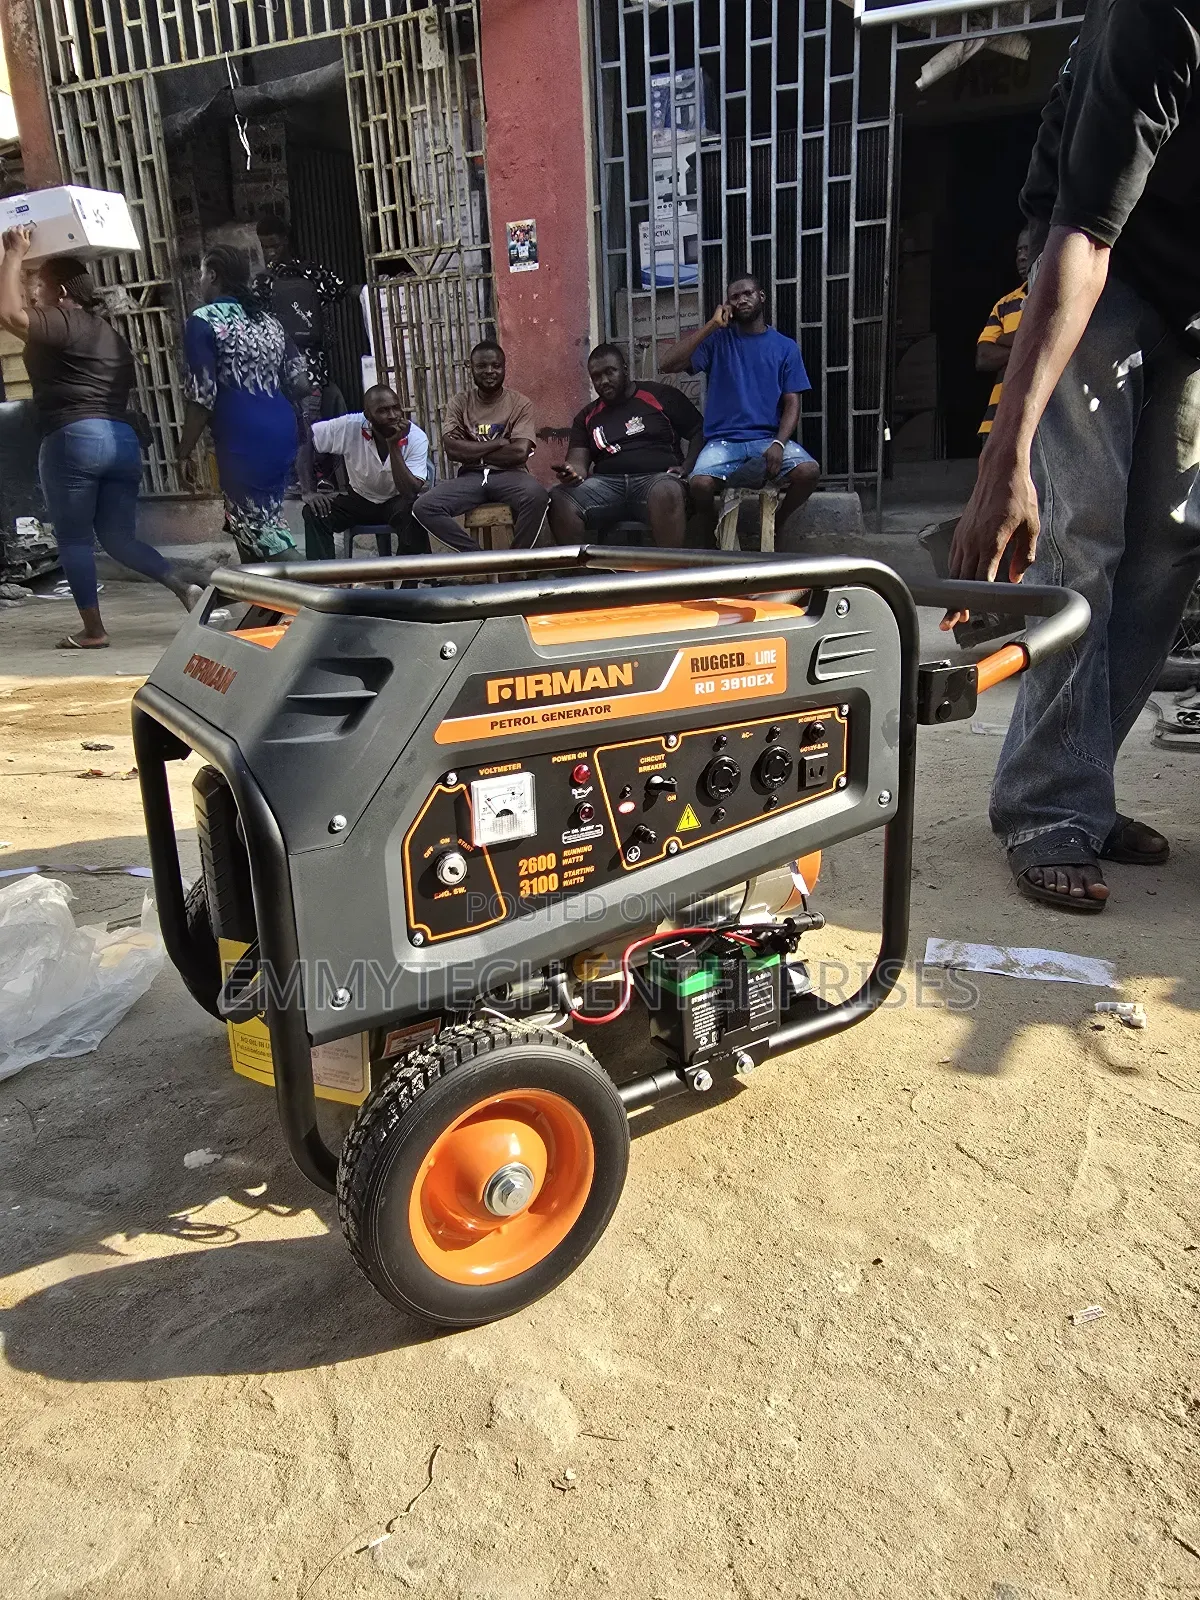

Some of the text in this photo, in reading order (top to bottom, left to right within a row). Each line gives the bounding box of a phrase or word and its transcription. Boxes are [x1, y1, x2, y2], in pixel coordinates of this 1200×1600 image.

[690, 649, 777, 673] RUGGED LINE
[183, 653, 238, 695] FIRMAN
[487, 662, 634, 704] FIRMAN
[694, 681, 715, 695] RD
[490, 704, 612, 730] PETROL GENERATOR
[552, 751, 588, 763] POWER ON
[640, 754, 666, 764] CIRCUIT
[478, 762, 522, 776] VOLTMETER
[638, 762, 667, 773] BREAKER
[666, 794, 677, 802] ON
[440, 837, 451, 845] ON
[457, 838, 474, 852] START
[563, 844, 593, 857] RUNNING
[518, 852, 556, 876] 2600
[562, 855, 584, 866] WATTS
[563, 865, 595, 878] STARTING
[520, 873, 559, 898] 3100
[562, 876, 585, 887] WATTS
